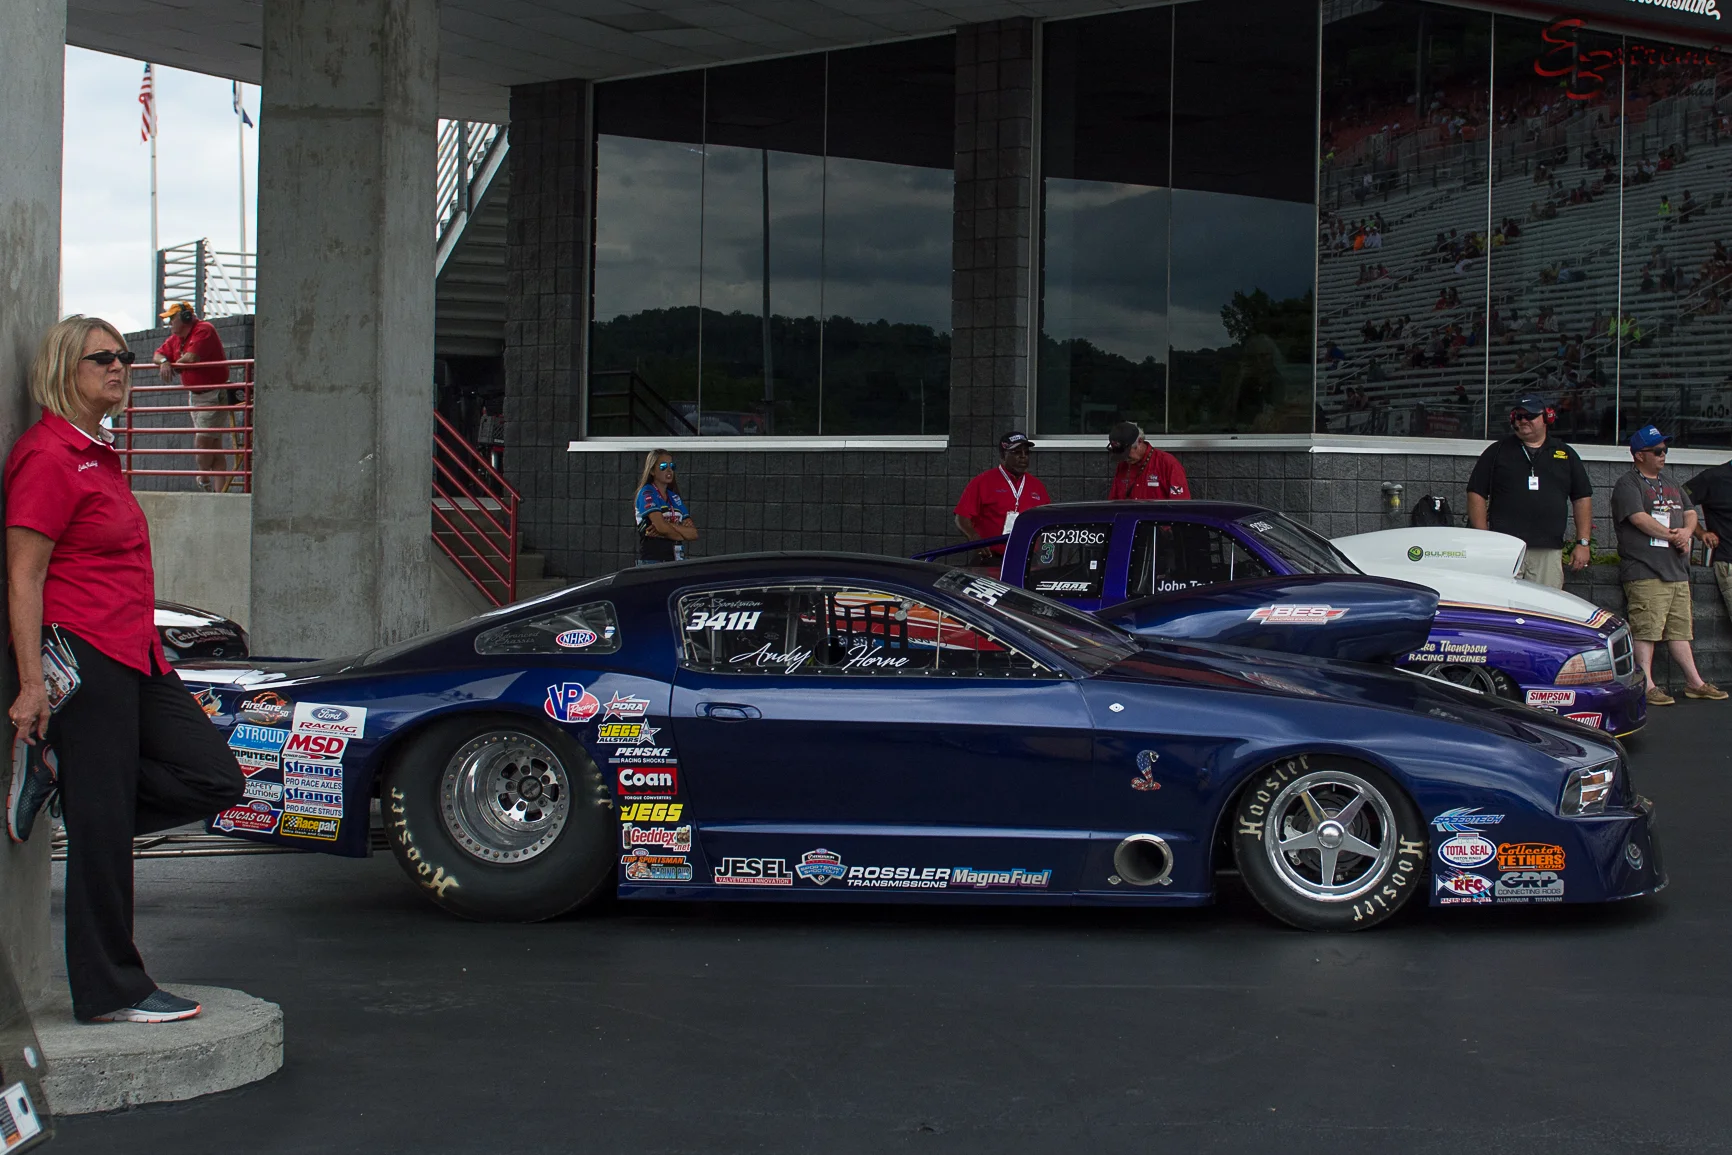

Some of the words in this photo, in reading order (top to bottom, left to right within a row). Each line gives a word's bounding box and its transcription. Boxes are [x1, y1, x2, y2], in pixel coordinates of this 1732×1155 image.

[1041, 530, 1105, 544] TS2318SC
[1158, 581, 1187, 592] John
[1272, 606, 1327, 617] BES
[686, 612, 764, 631] 341H
[562, 633, 591, 643] NHRA
[1440, 640, 1488, 655] Thompson
[729, 642, 811, 674] Andy
[841, 645, 909, 671] Horne
[1408, 654, 1444, 662] RACING
[1446, 655, 1487, 663] ENGINES
[547, 683, 584, 722] VP
[1529, 692, 1571, 701] SIMPSON
[241, 700, 281, 712] FireCore
[279, 710, 289, 718] 50
[570, 703, 598, 716] Racing
[611, 703, 643, 711] PDRA
[317, 708, 342, 720] Ford
[299, 722, 358, 733] RACING
[601, 725, 641, 737] JEGS
[237, 725, 285, 744] STROUD
[287, 734, 344, 754] MSD
[615, 747, 671, 757] PENSKE
[285, 761, 342, 777] Strange
[619, 768, 672, 786] Coan
[286, 778, 299, 786] PRO
[301, 779, 320, 788] RACE
[320, 782, 342, 790] AXLES
[245, 789, 279, 799] OLUTIONS
[285, 787, 342, 804] Strange
[1239, 755, 1309, 841] Hoosier
[223, 810, 257, 821] LUCAS
[256, 814, 272, 823] OIL
[286, 804, 299, 812] PRO
[300, 806, 317, 814] RACE
[317, 808, 342, 817] STRUTS
[620, 803, 683, 822] JEGS
[296, 817, 337, 832] Racepak
[1431, 815, 1505, 825] SPEEDTECH
[391, 786, 460, 898] Hoosier
[632, 827, 676, 846] Geddex
[1445, 846, 1468, 856] TOTAL
[1470, 846, 1489, 856] SEAL
[1499, 844, 1562, 855] Collector
[623, 856, 638, 864] TOP
[638, 856, 684, 865] SPORTSMAN
[1498, 855, 1563, 865] TETHERS
[651, 866, 675, 878] RACING
[715, 858, 788, 878] JESEL
[848, 866, 951, 880] ROSSLER
[847, 879, 947, 888] TRANSMISSIONS
[952, 867, 1050, 887] MagnaFuel
[1353, 834, 1424, 922] Hoosier
[1500, 872, 1558, 888] GRP
[1454, 879, 1483, 891] RFC
